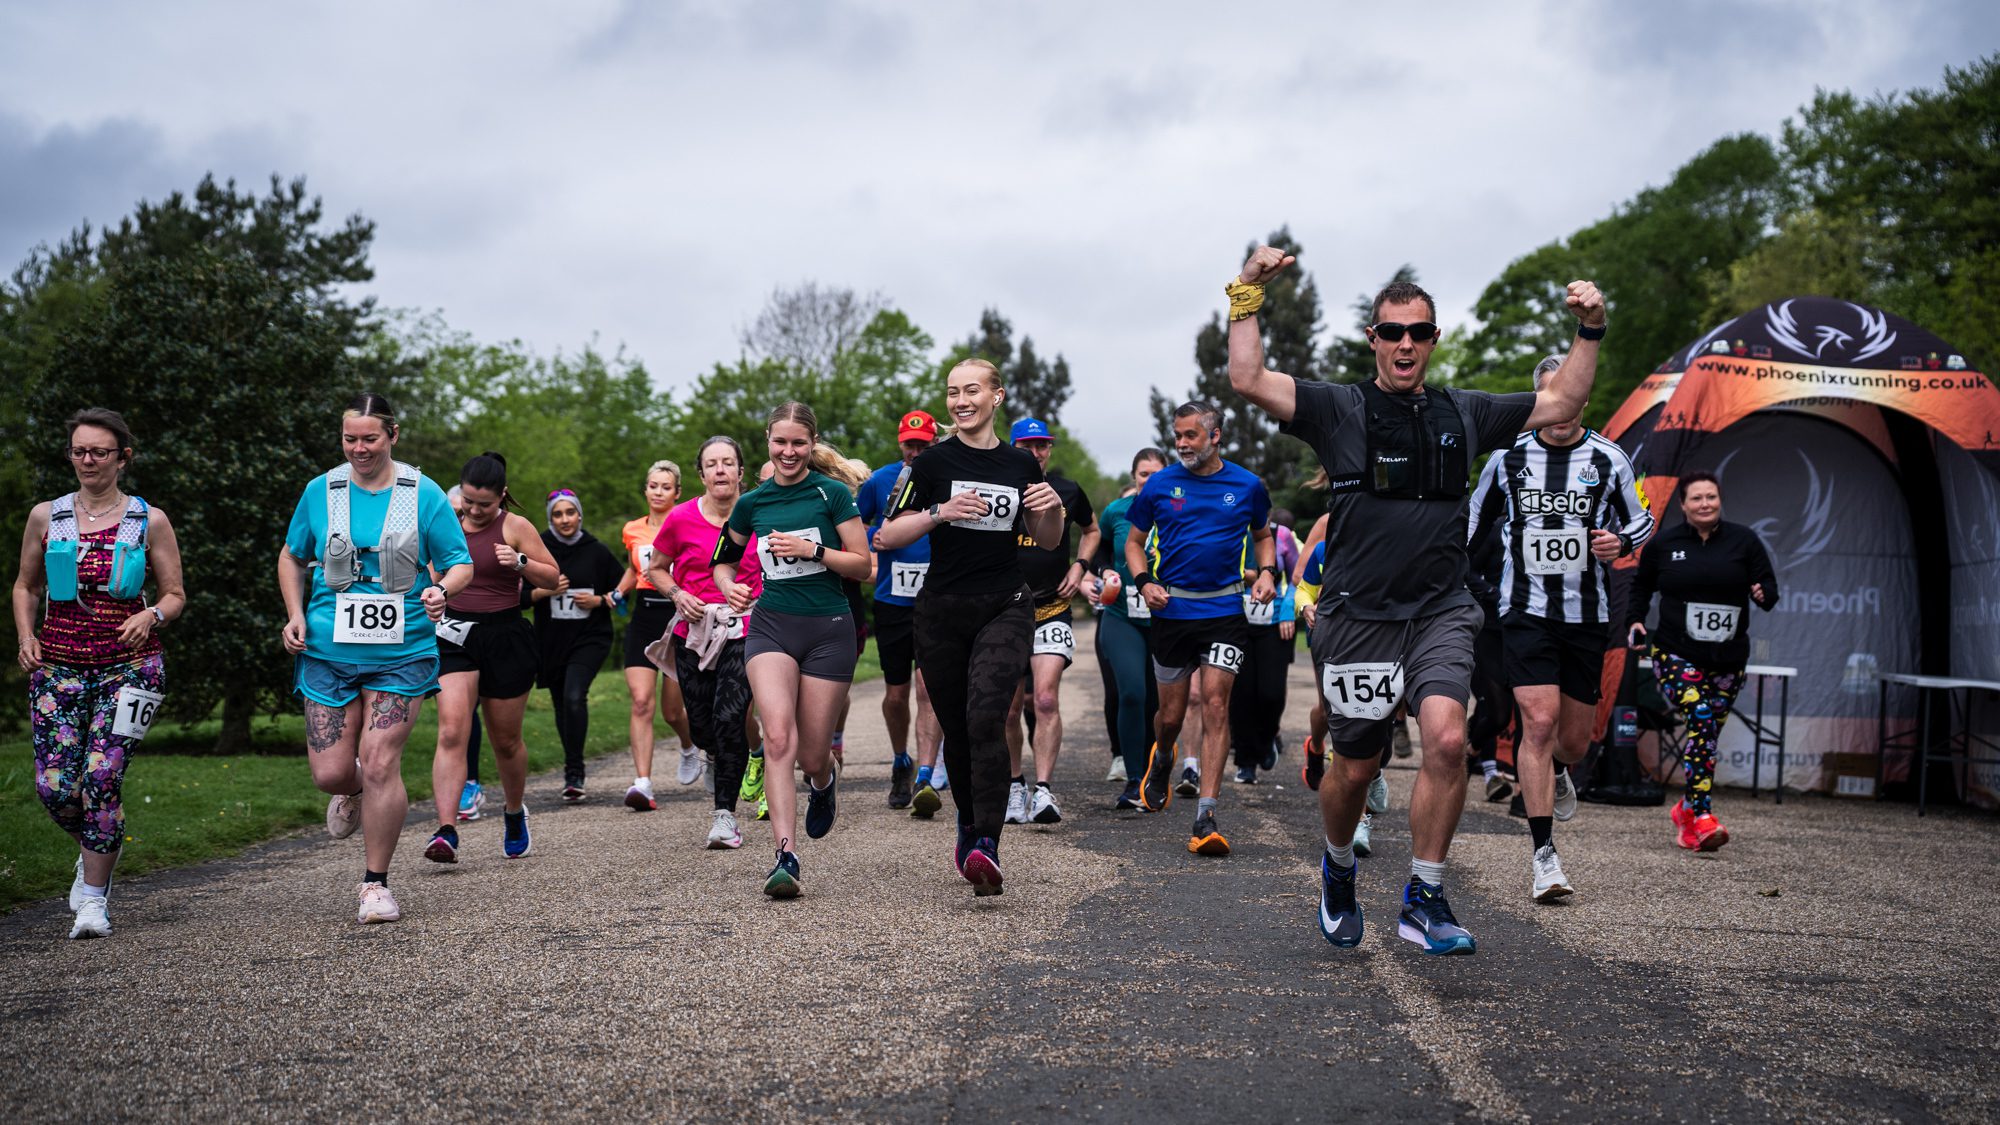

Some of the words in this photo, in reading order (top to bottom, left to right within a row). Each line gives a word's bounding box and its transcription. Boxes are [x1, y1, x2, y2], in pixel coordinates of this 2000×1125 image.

[1697, 360, 1987, 392] www.phoenixrunning.co.uk
[979, 493, 1011, 518] 58
[1540, 490, 1592, 515] sela
[1530, 538, 1580, 562] 180
[897, 570, 926, 588] 17
[344, 604, 397, 630] 189
[1694, 611, 1733, 632] 184
[1040, 627, 1073, 648] 188
[1331, 675, 1396, 704] 154
